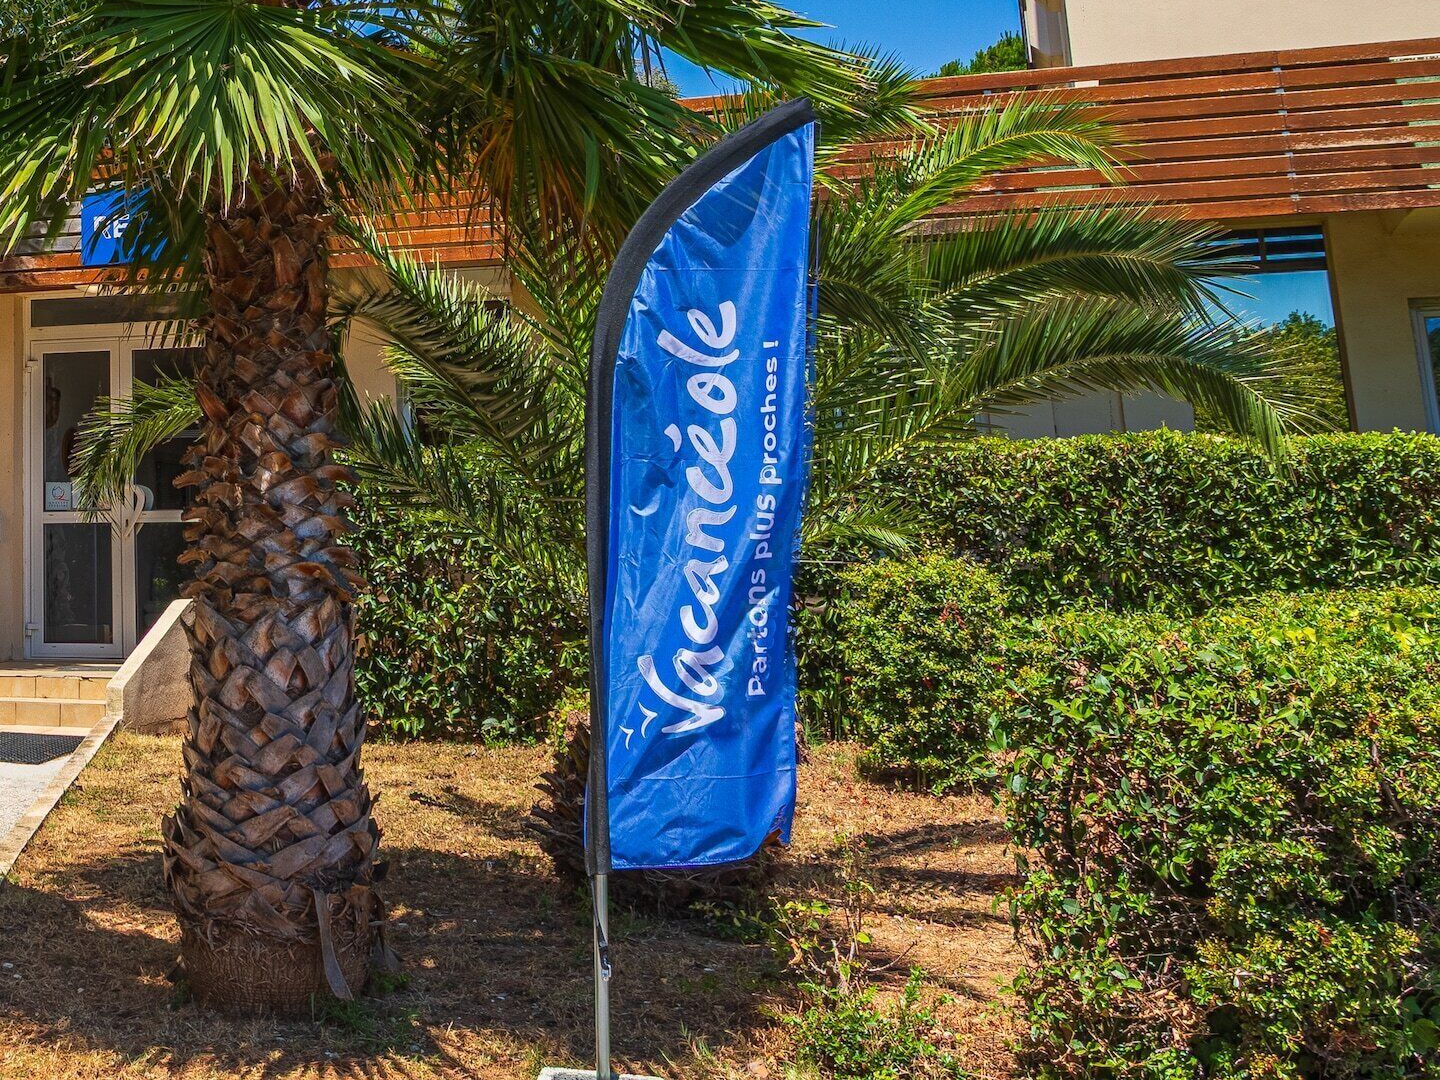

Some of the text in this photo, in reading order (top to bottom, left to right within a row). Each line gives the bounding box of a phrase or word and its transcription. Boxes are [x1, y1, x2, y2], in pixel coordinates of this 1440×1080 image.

[637, 300, 740, 734] Vacancéole
[750, 495, 777, 560] plus
[747, 569, 768, 696] Partons
